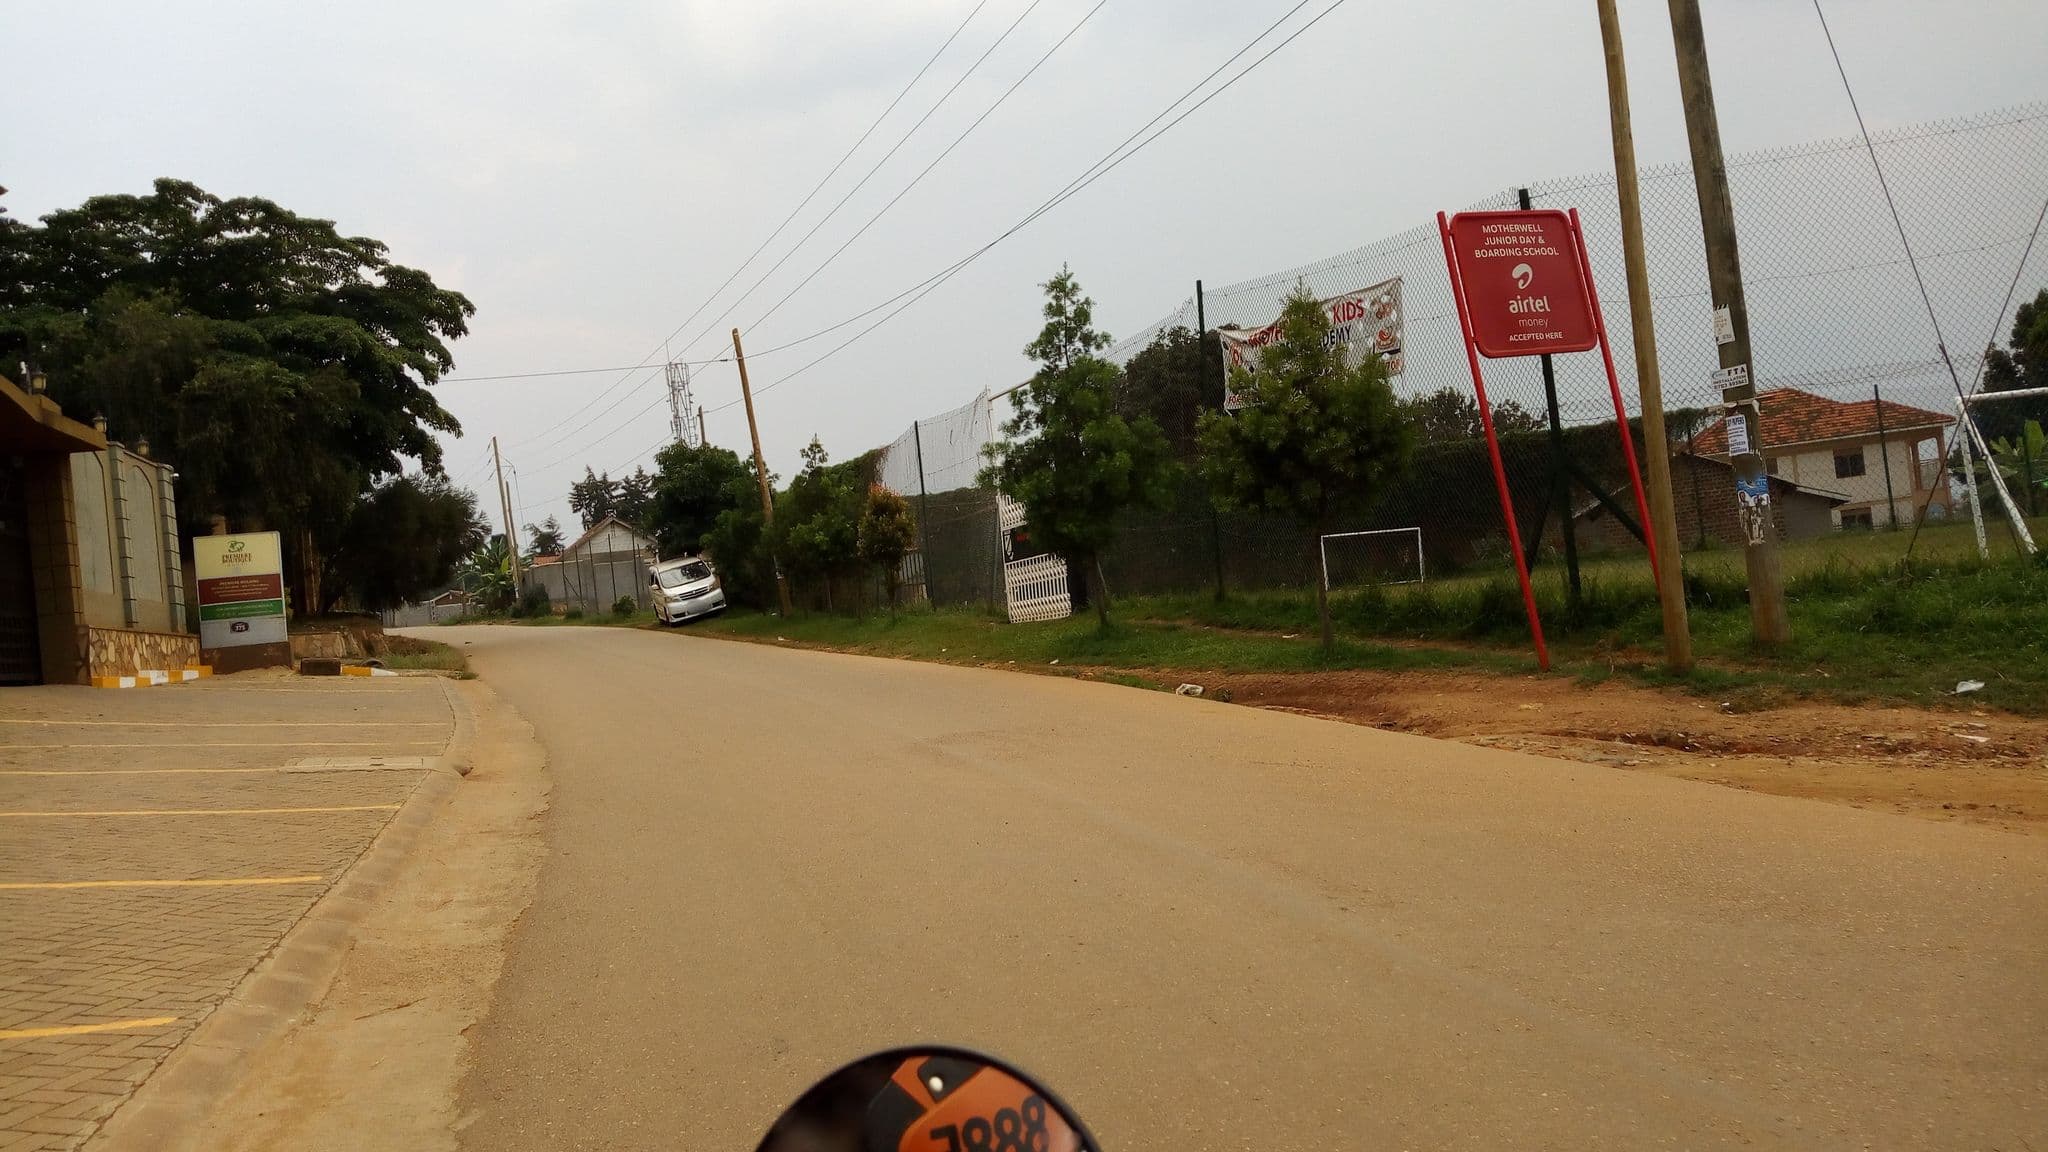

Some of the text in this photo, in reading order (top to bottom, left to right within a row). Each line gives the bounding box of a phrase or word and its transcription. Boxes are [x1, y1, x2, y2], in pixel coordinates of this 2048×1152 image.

[1482, 224, 1544, 233] MOTHERWELL
[1484, 236, 1545, 246] JUNIOR DAY &
[1475, 247, 1559, 258] BOARDING SCHOOL
[1508, 295, 1551, 314] airtel
[1332, 298, 1364, 324] KIDS
[1518, 318, 1549, 328] money
[1509, 331, 1563, 342] ACCEPTED HERE
[1727, 366, 1746, 377] FTA
